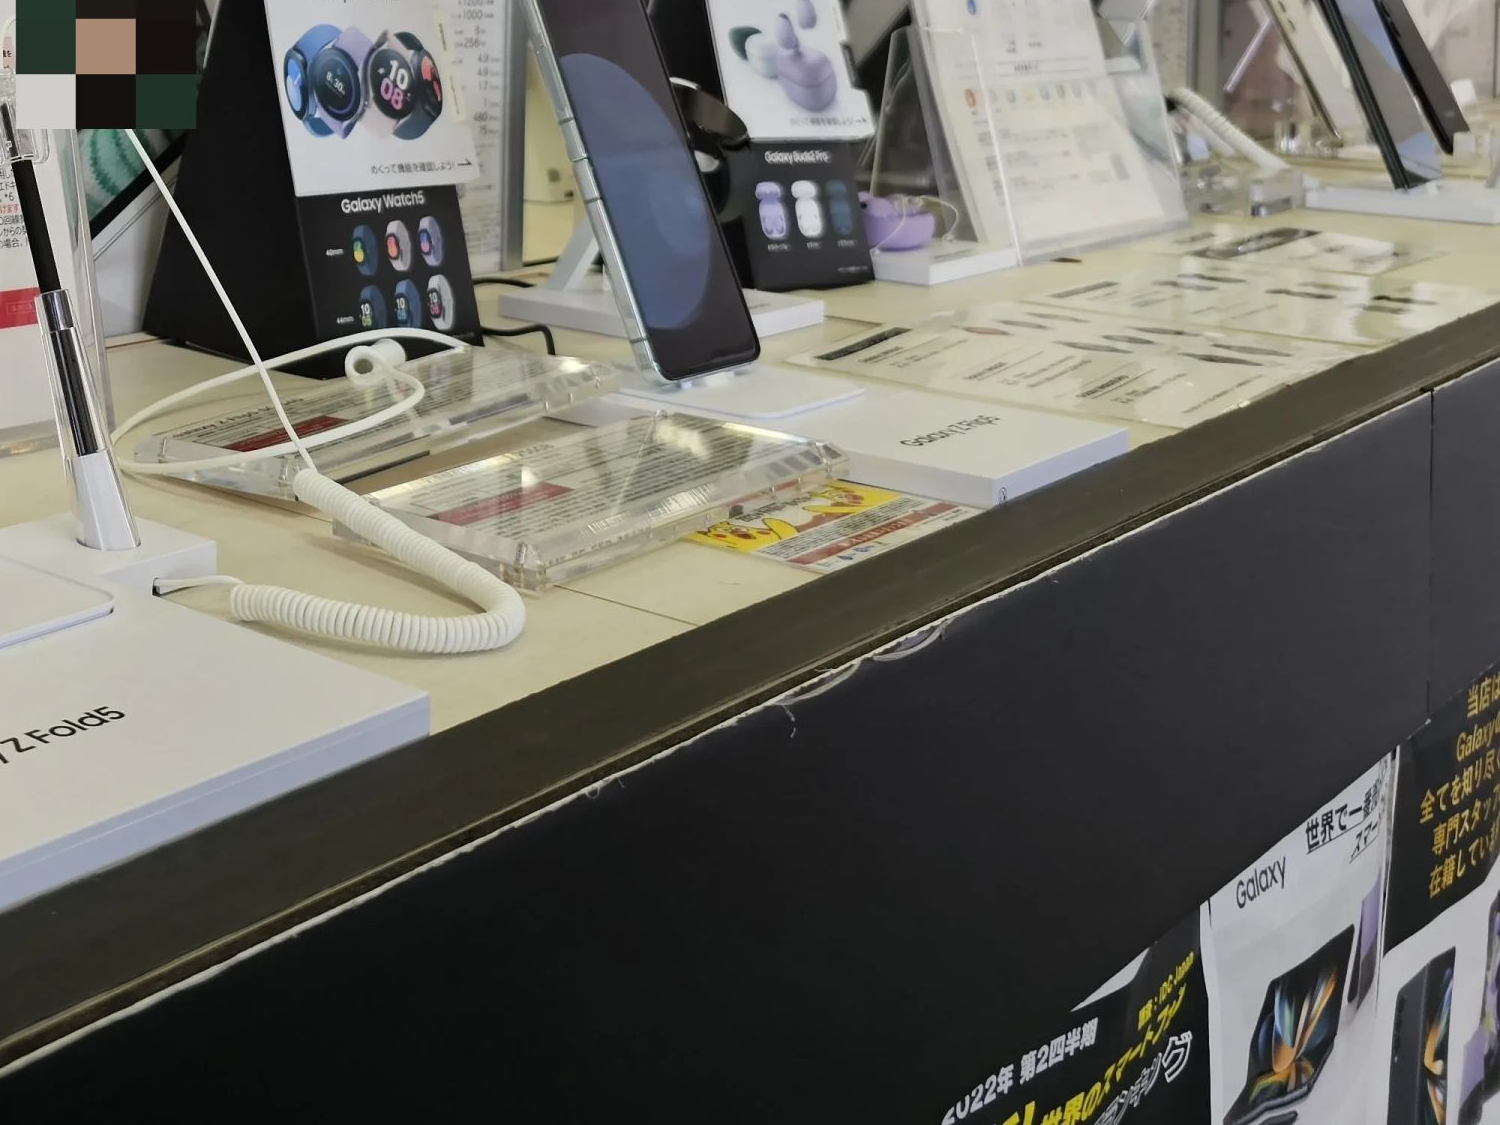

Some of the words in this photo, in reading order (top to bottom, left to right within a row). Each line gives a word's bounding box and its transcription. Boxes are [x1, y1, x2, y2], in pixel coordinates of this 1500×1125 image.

[341, 195, 382, 214] Galaxy
[382, 190, 425, 208] Watch5
[24, 706, 125, 744] Fold5
[1236, 856, 1286, 909] Galaxy
[1019, 1017, 1098, 1085] 第2四半期
